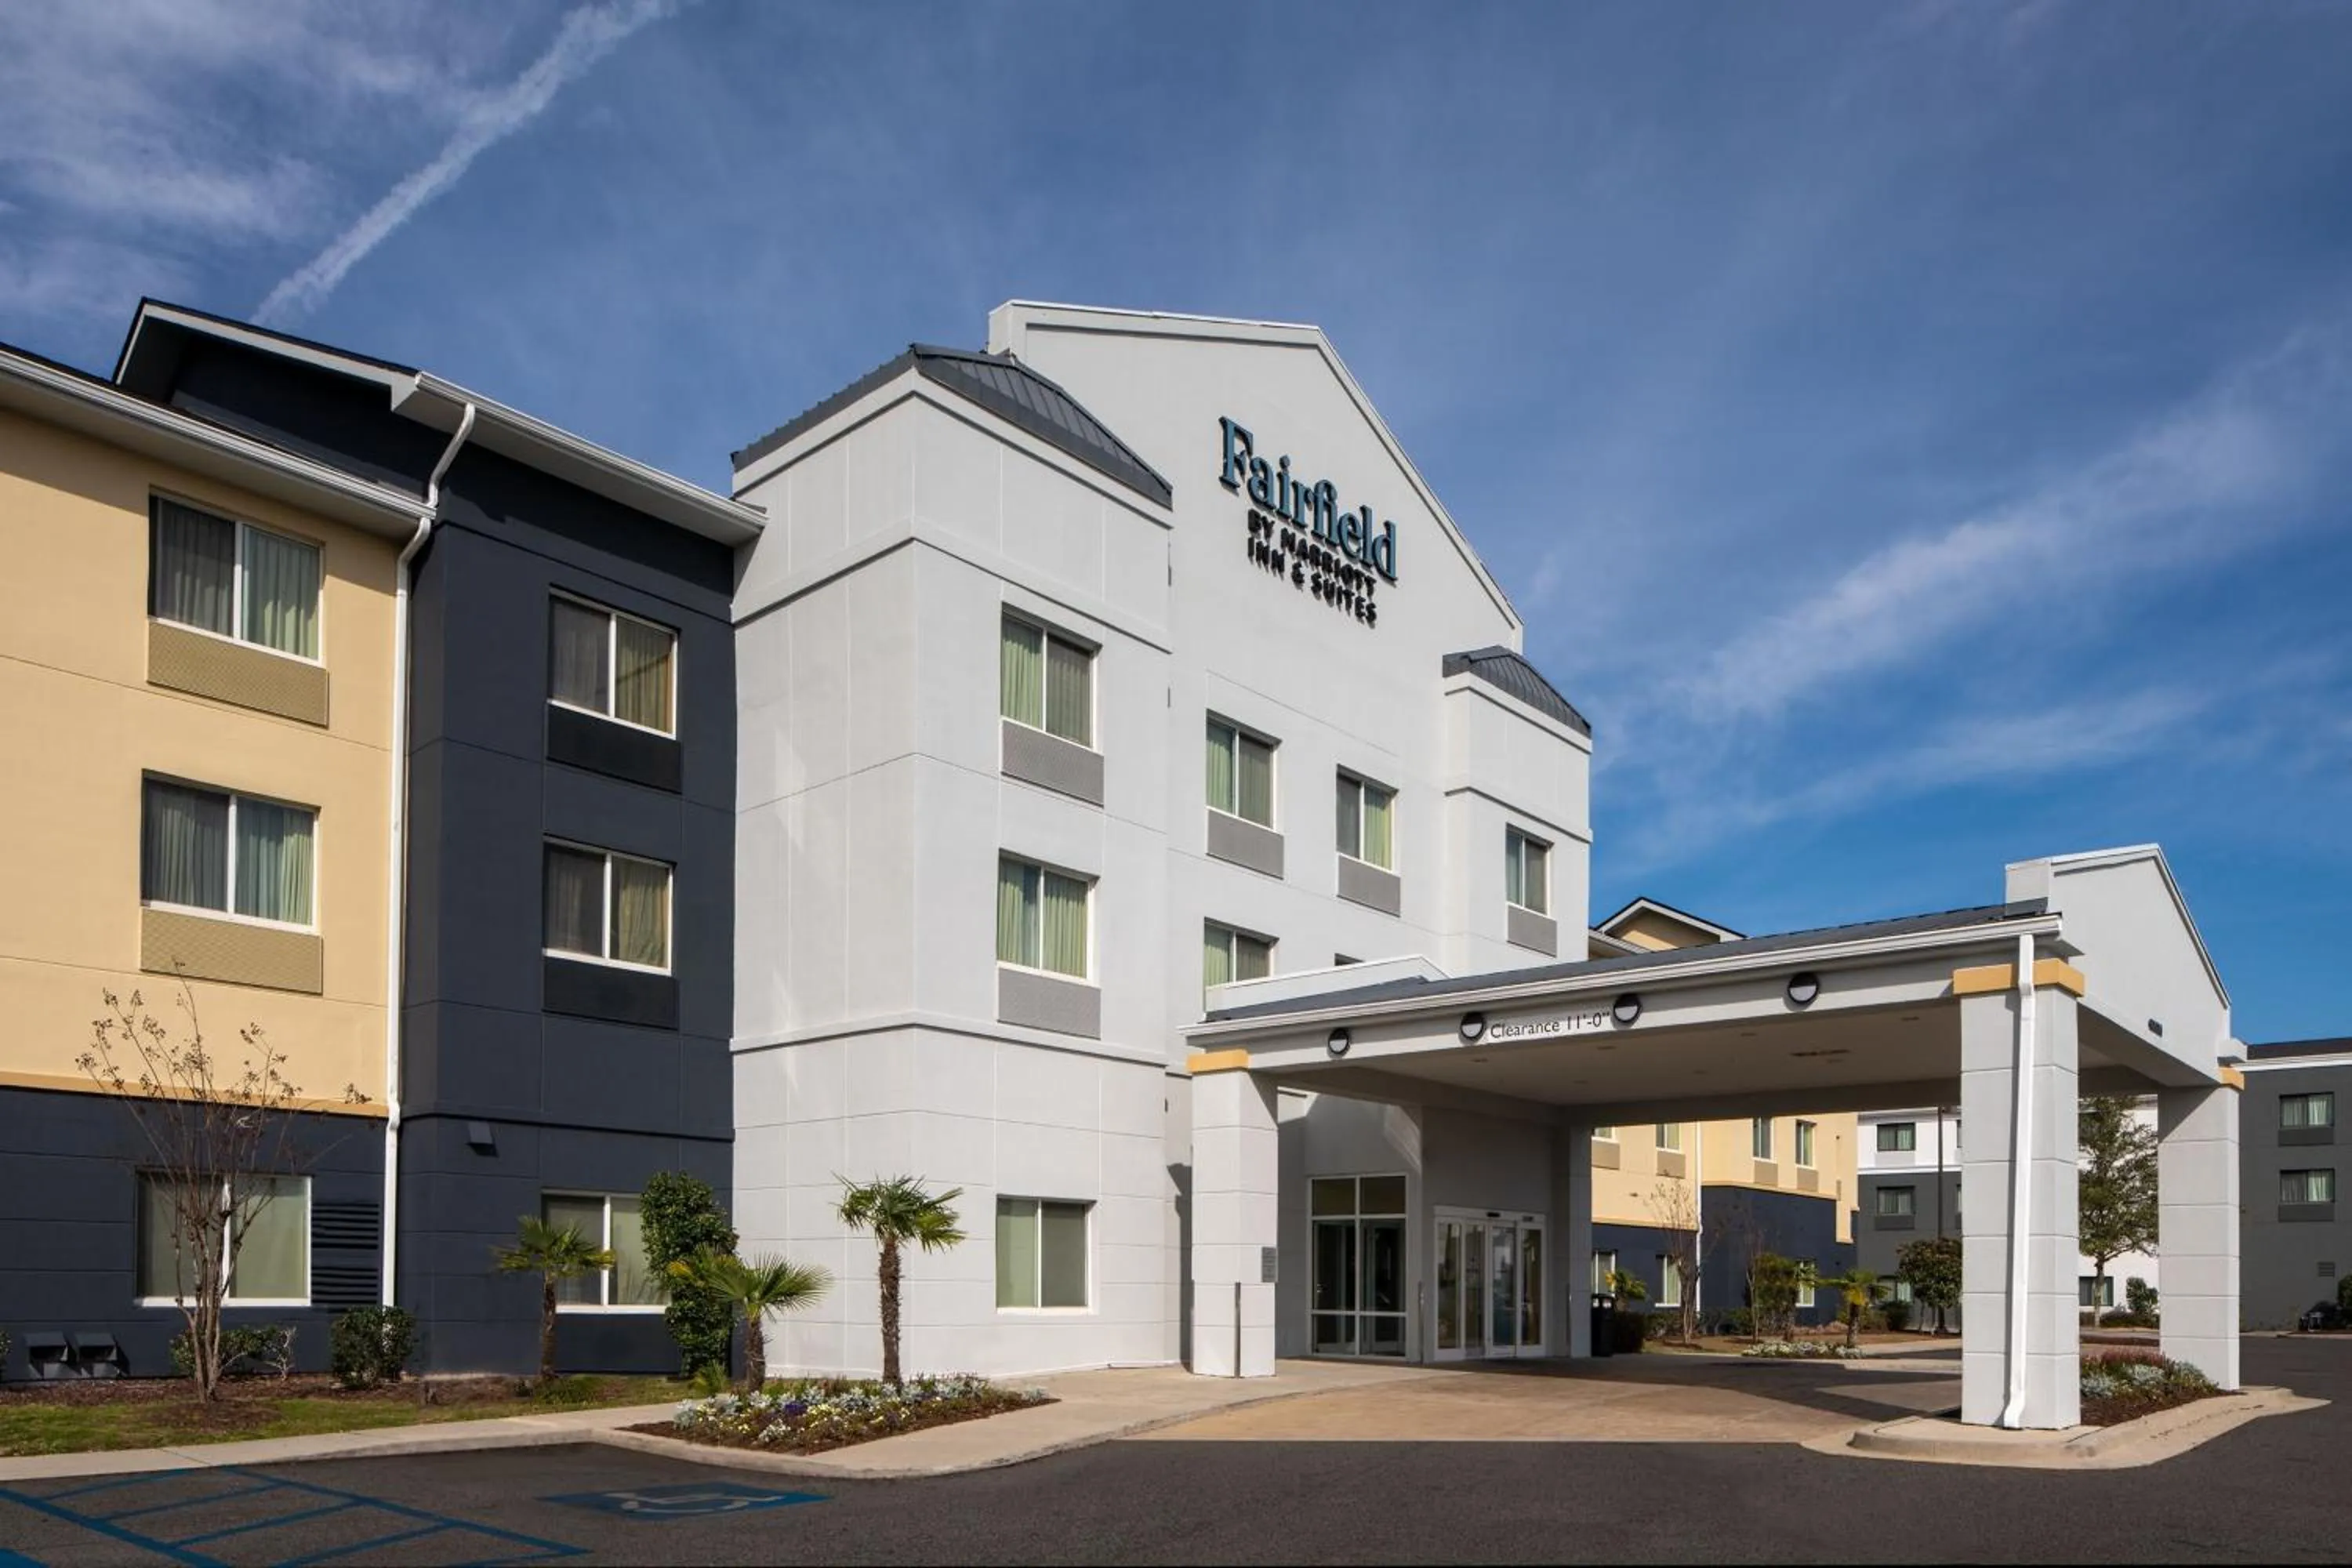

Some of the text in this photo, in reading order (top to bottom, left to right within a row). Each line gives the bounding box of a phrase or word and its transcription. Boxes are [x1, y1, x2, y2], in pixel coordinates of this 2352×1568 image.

[1218, 416, 1398, 583] Fairfield
[1248, 508, 1377, 597] BY MARRIOTT
[1248, 537, 1377, 625] INN & SUITES
[1490, 1021, 1560, 1039] Clearance
